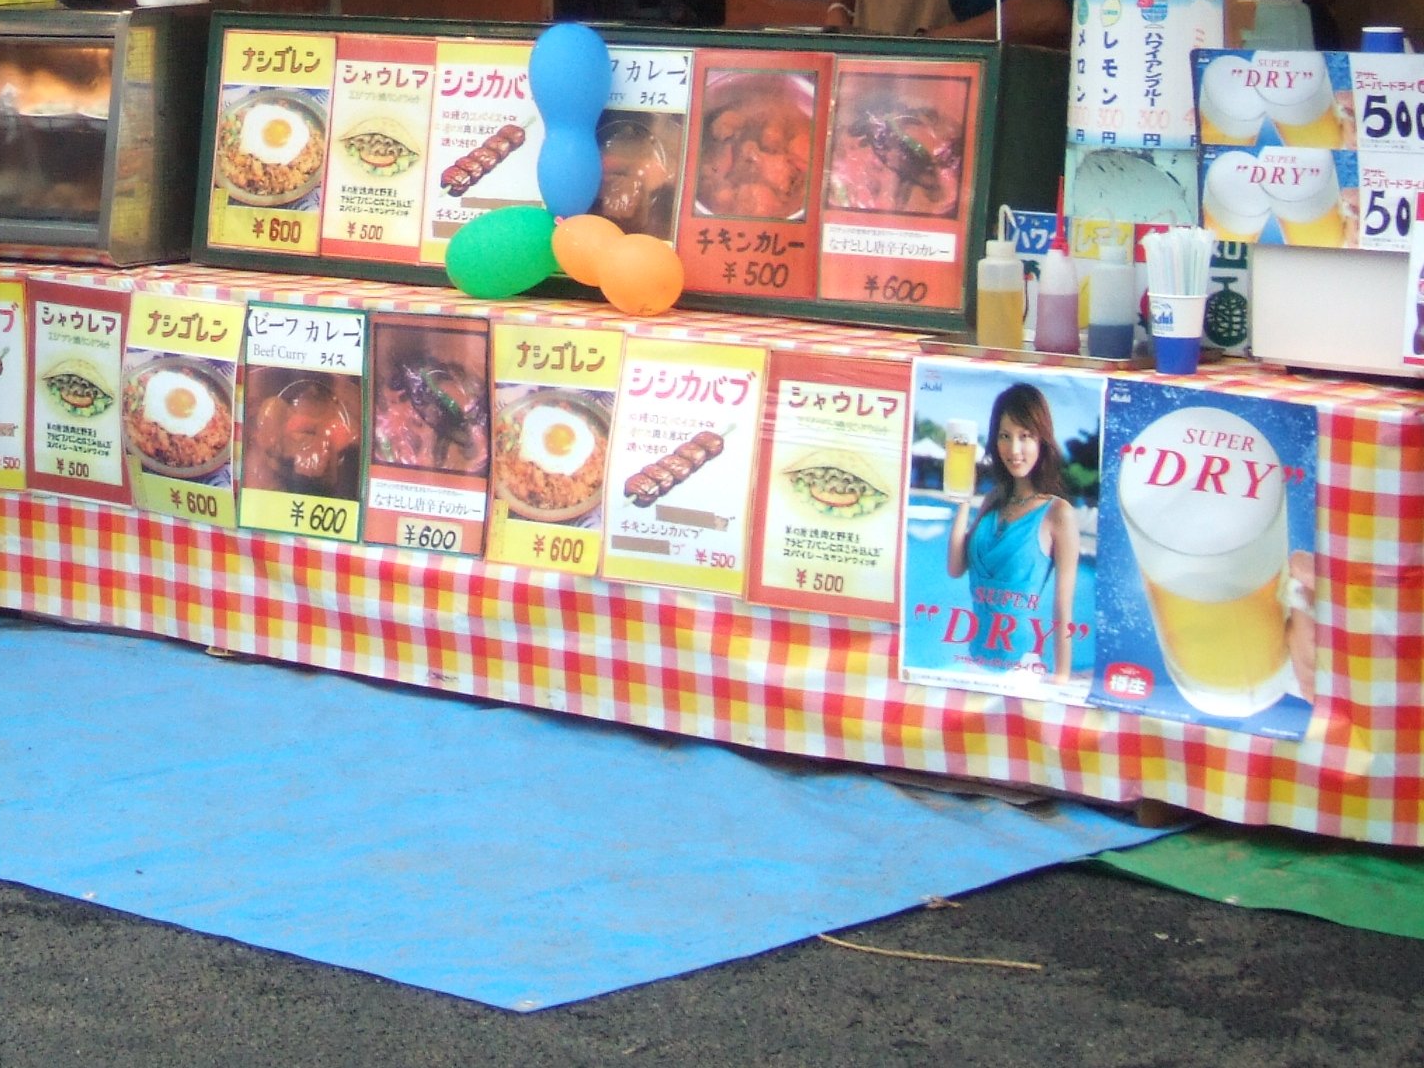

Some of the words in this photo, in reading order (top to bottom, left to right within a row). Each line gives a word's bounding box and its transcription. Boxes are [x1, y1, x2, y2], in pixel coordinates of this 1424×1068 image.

[242, 45, 321, 74] ナシゴレン
[1102, 30, 1118, 106] レモン
[1257, 58, 1290, 68] SUPER
[343, 64, 429, 89] シャウレマ
[440, 68, 526, 100] シシカバ
[1355, 80, 1415, 91] スーパードライ
[1142, 133, 1161, 146] 円
[1263, 154, 1297, 165] SUPER
[696, 228, 805, 254] チキンカレー
[41, 305, 118, 336] シャウレマ
[147, 309, 228, 343] ナシゴレン
[253, 342, 276, 358] Beef
[277, 344, 308, 364] Curry
[515, 340, 606, 373] ナシゴレン
[627, 367, 757, 407] シシカバブ
[787, 385, 899, 419] シャウレマ
[1182, 427, 1256, 453] SUPER
[975, 587, 1041, 611] SUPER
